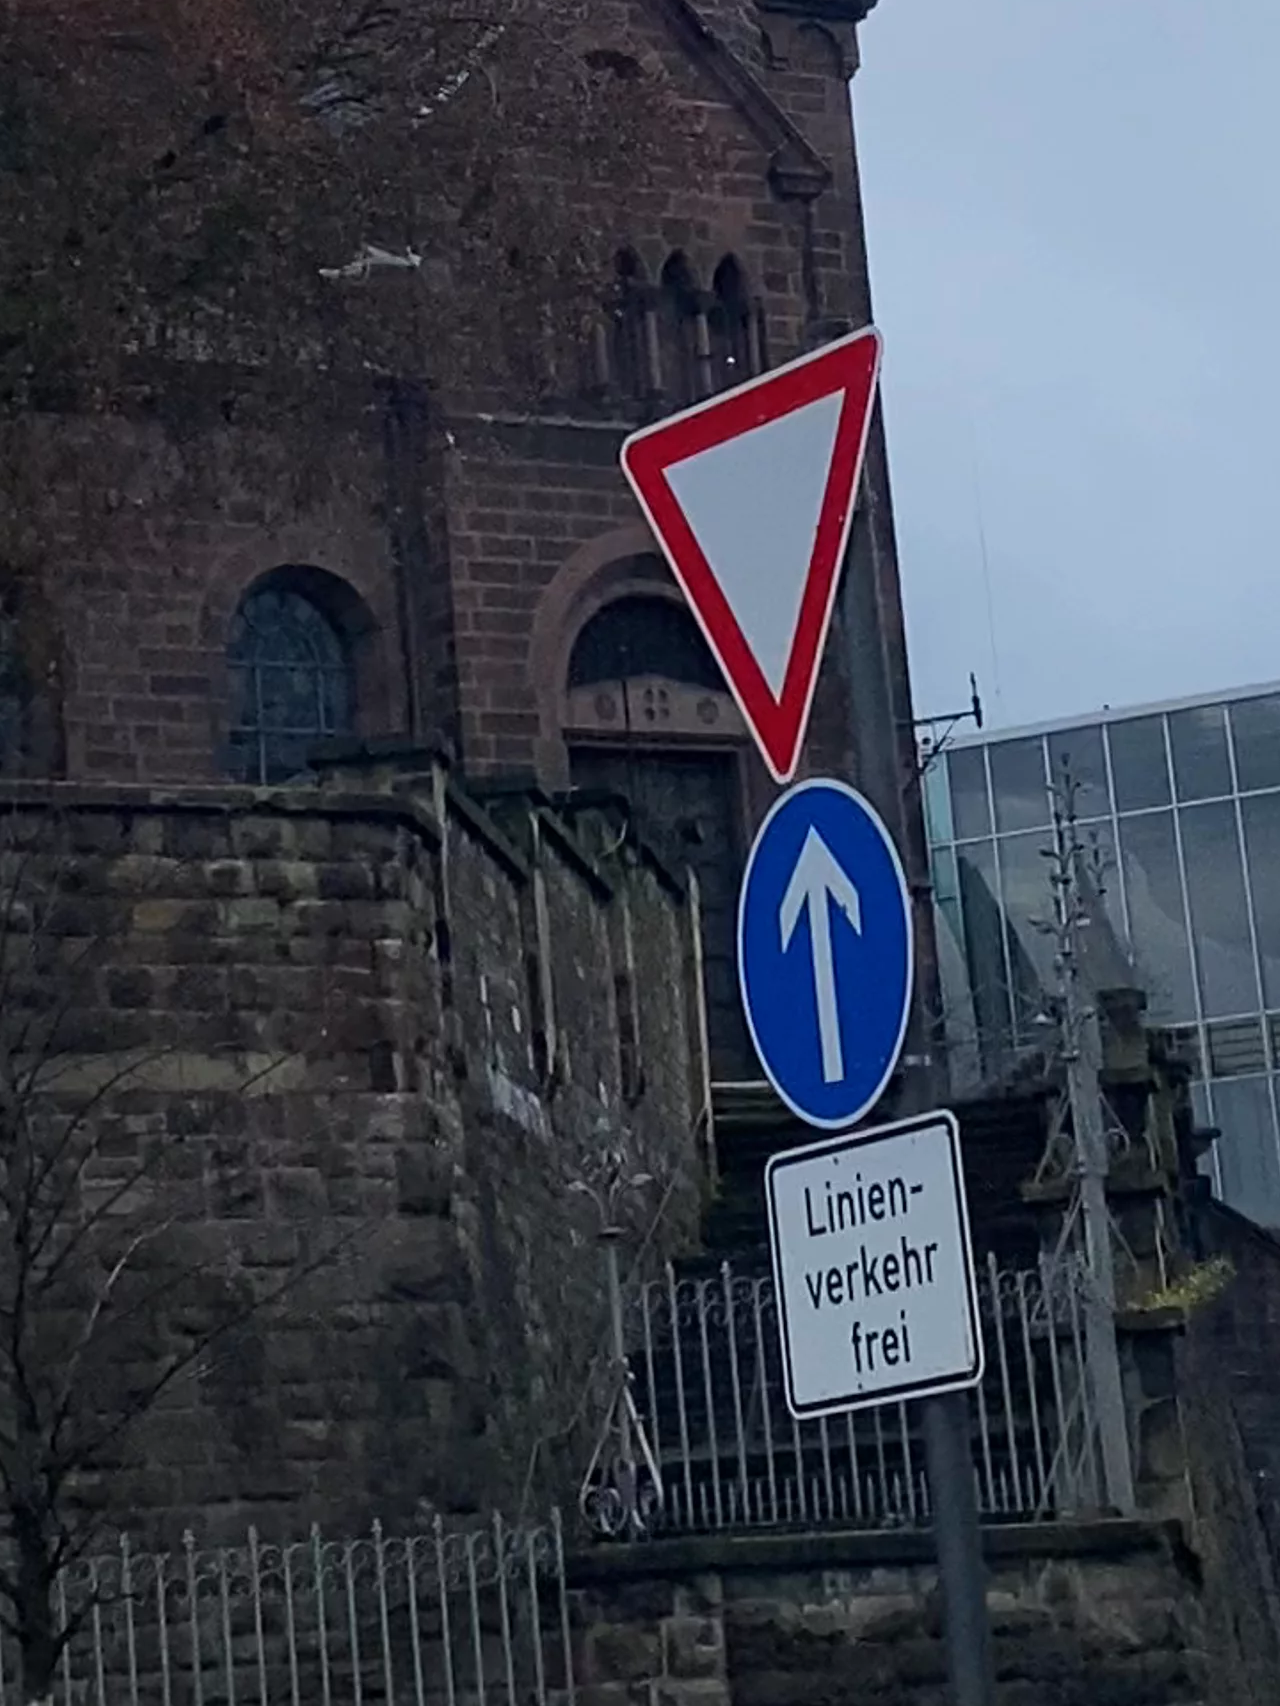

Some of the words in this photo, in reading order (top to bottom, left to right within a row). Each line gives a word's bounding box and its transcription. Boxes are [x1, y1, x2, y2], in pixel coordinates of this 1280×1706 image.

[804, 1172, 923, 1237] Linien-
[805, 1236, 938, 1309] verkehr
[851, 1309, 911, 1373] frei
